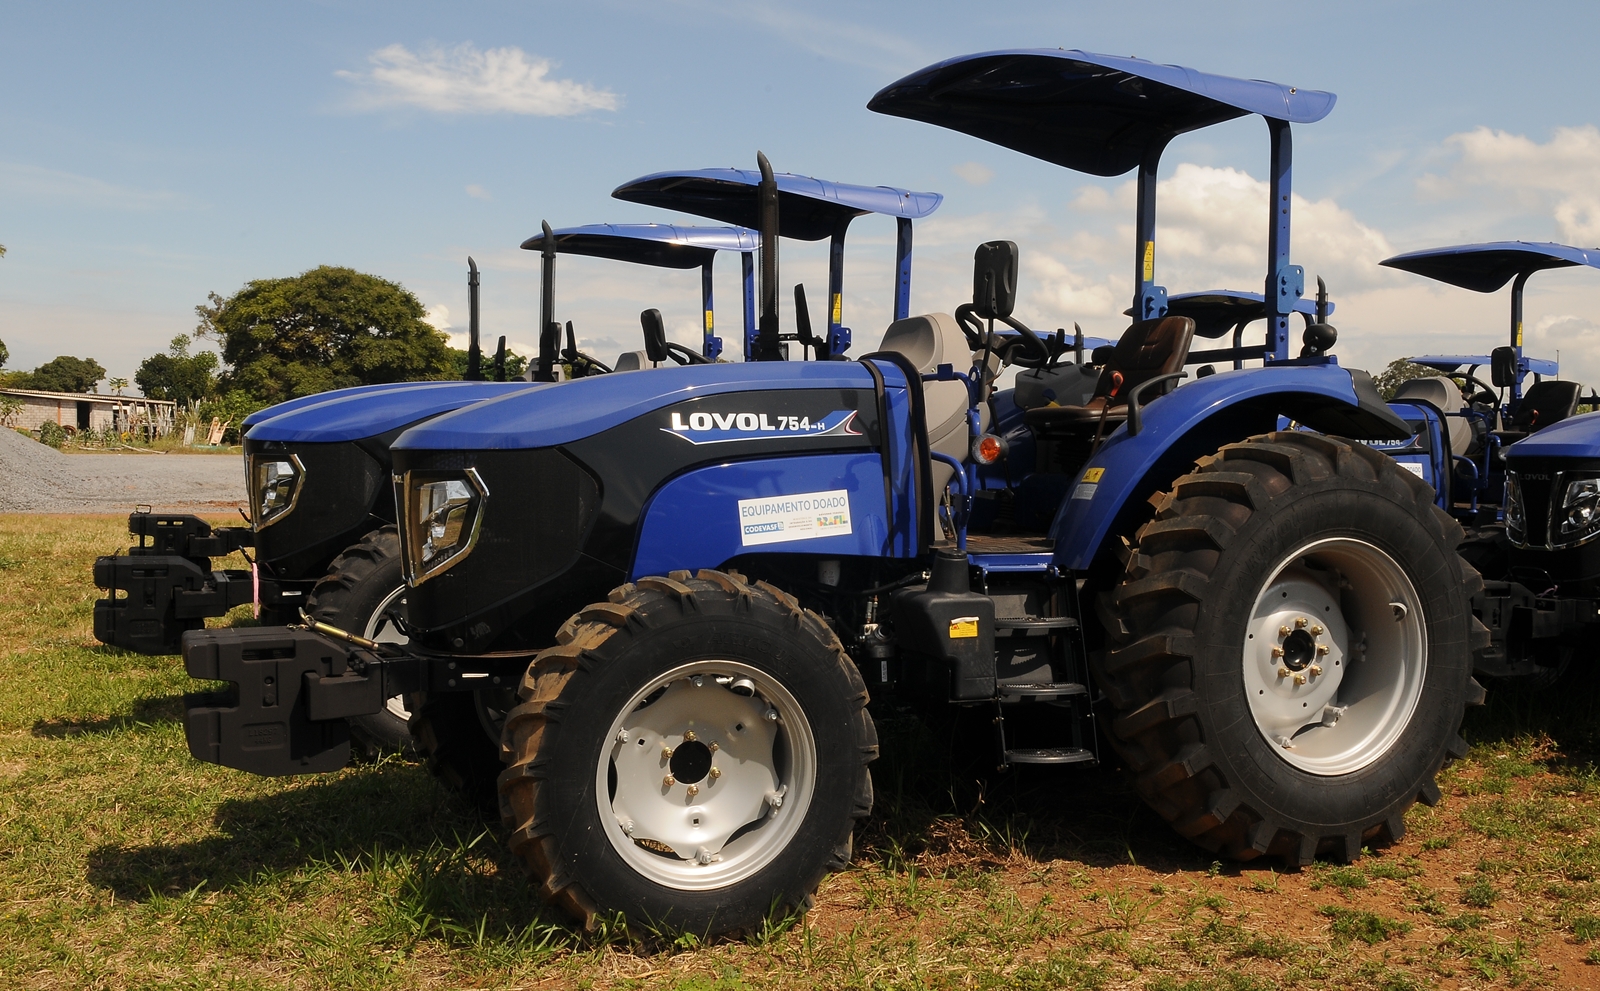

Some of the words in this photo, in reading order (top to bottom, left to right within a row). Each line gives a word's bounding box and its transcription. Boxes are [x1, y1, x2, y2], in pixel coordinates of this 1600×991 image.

[671, 412, 776, 431] LOVOL
[777, 416, 826, 431] 754-H
[1520, 473, 1551, 481] LOVOL
[742, 500, 811, 518] EQUIPAMENTO
[813, 496, 846, 510] DOADO
[744, 523, 779, 534] CODEVASF
